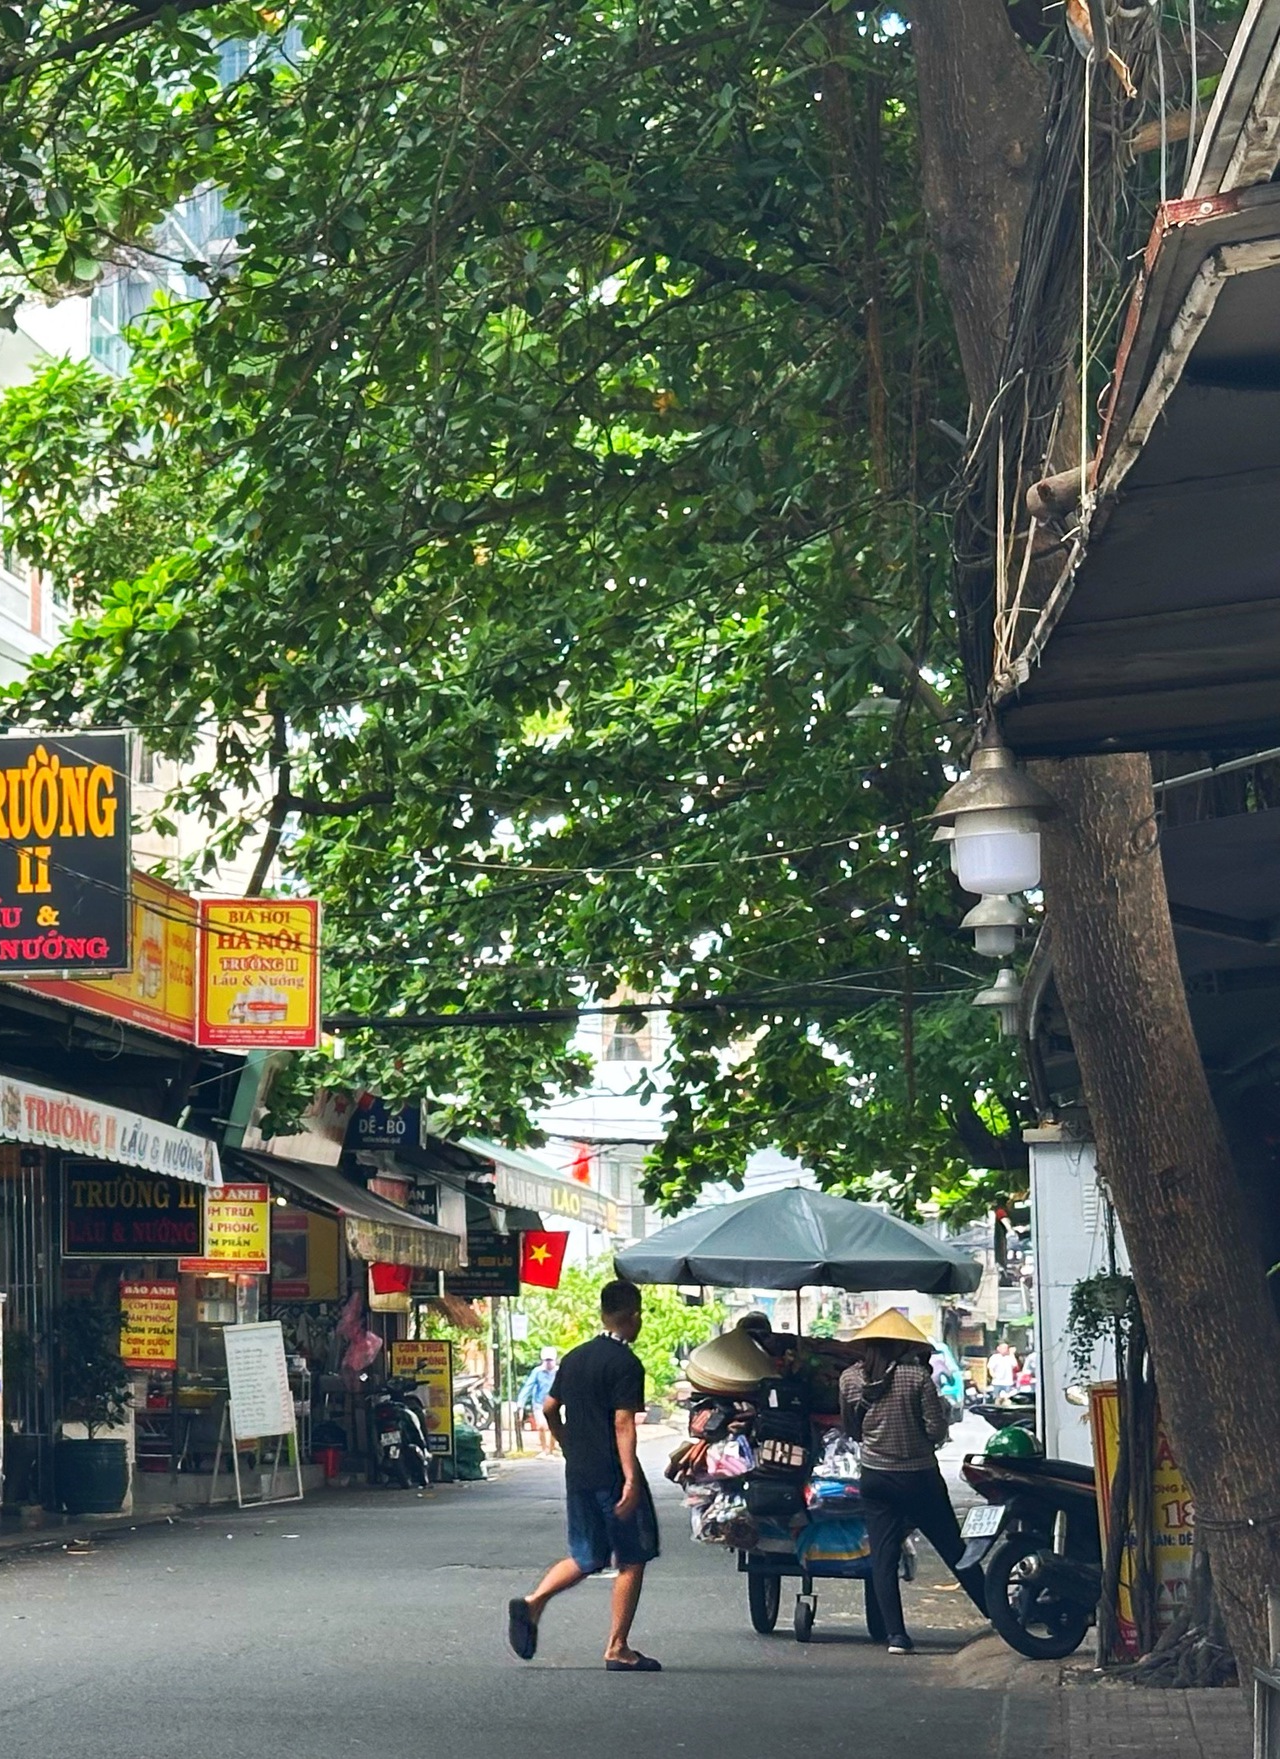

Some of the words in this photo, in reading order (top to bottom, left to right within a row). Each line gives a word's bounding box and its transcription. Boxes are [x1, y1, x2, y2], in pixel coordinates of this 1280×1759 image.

[17, 846, 52, 893] II
[36, 905, 60, 926] &
[228, 910, 255, 923] BIA
[219, 953, 285, 971] TRƯỜNG
[242, 974, 253, 986] &
[24, 1094, 101, 1145] TRƯỜNG
[72, 1172, 170, 1209] TRƯỜNG
[225, 1189, 260, 1200] ANH
